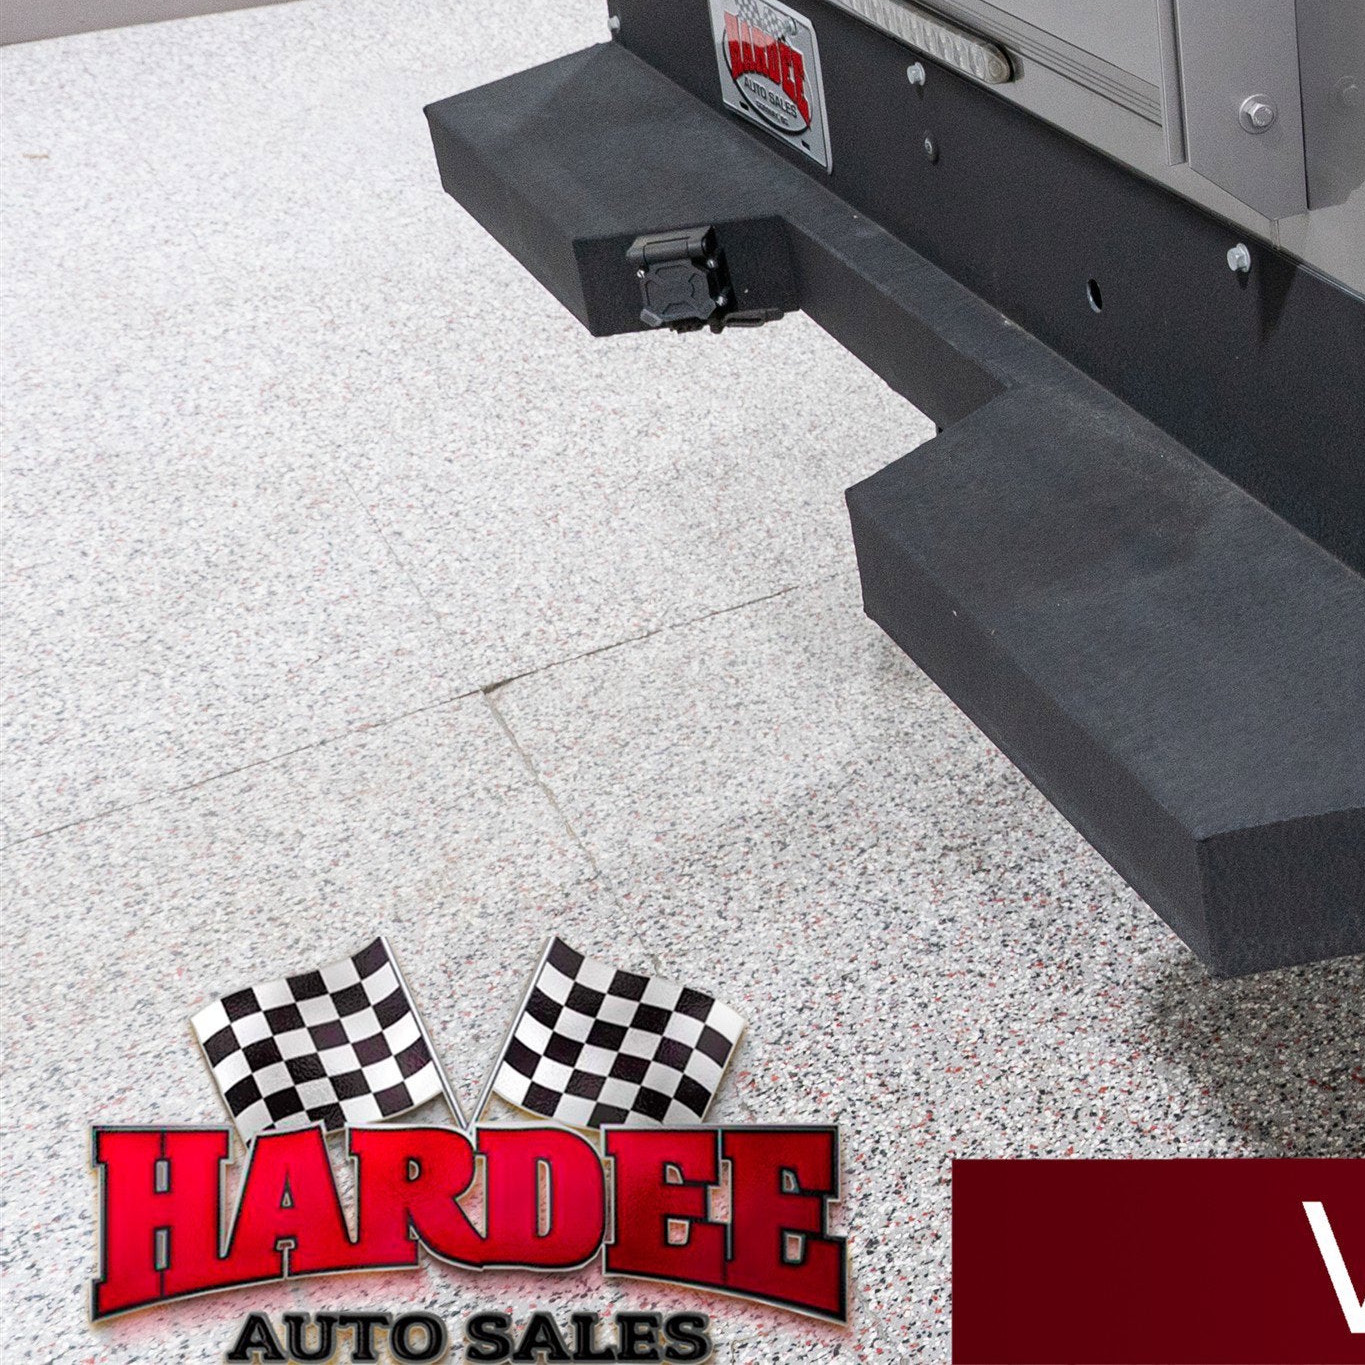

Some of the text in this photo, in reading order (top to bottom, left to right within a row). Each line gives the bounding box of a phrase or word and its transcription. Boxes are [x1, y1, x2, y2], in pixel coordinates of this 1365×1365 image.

[723, 11, 812, 129] HARDEE
[744, 76, 767, 100] AUTO
[768, 89, 798, 119] SALES
